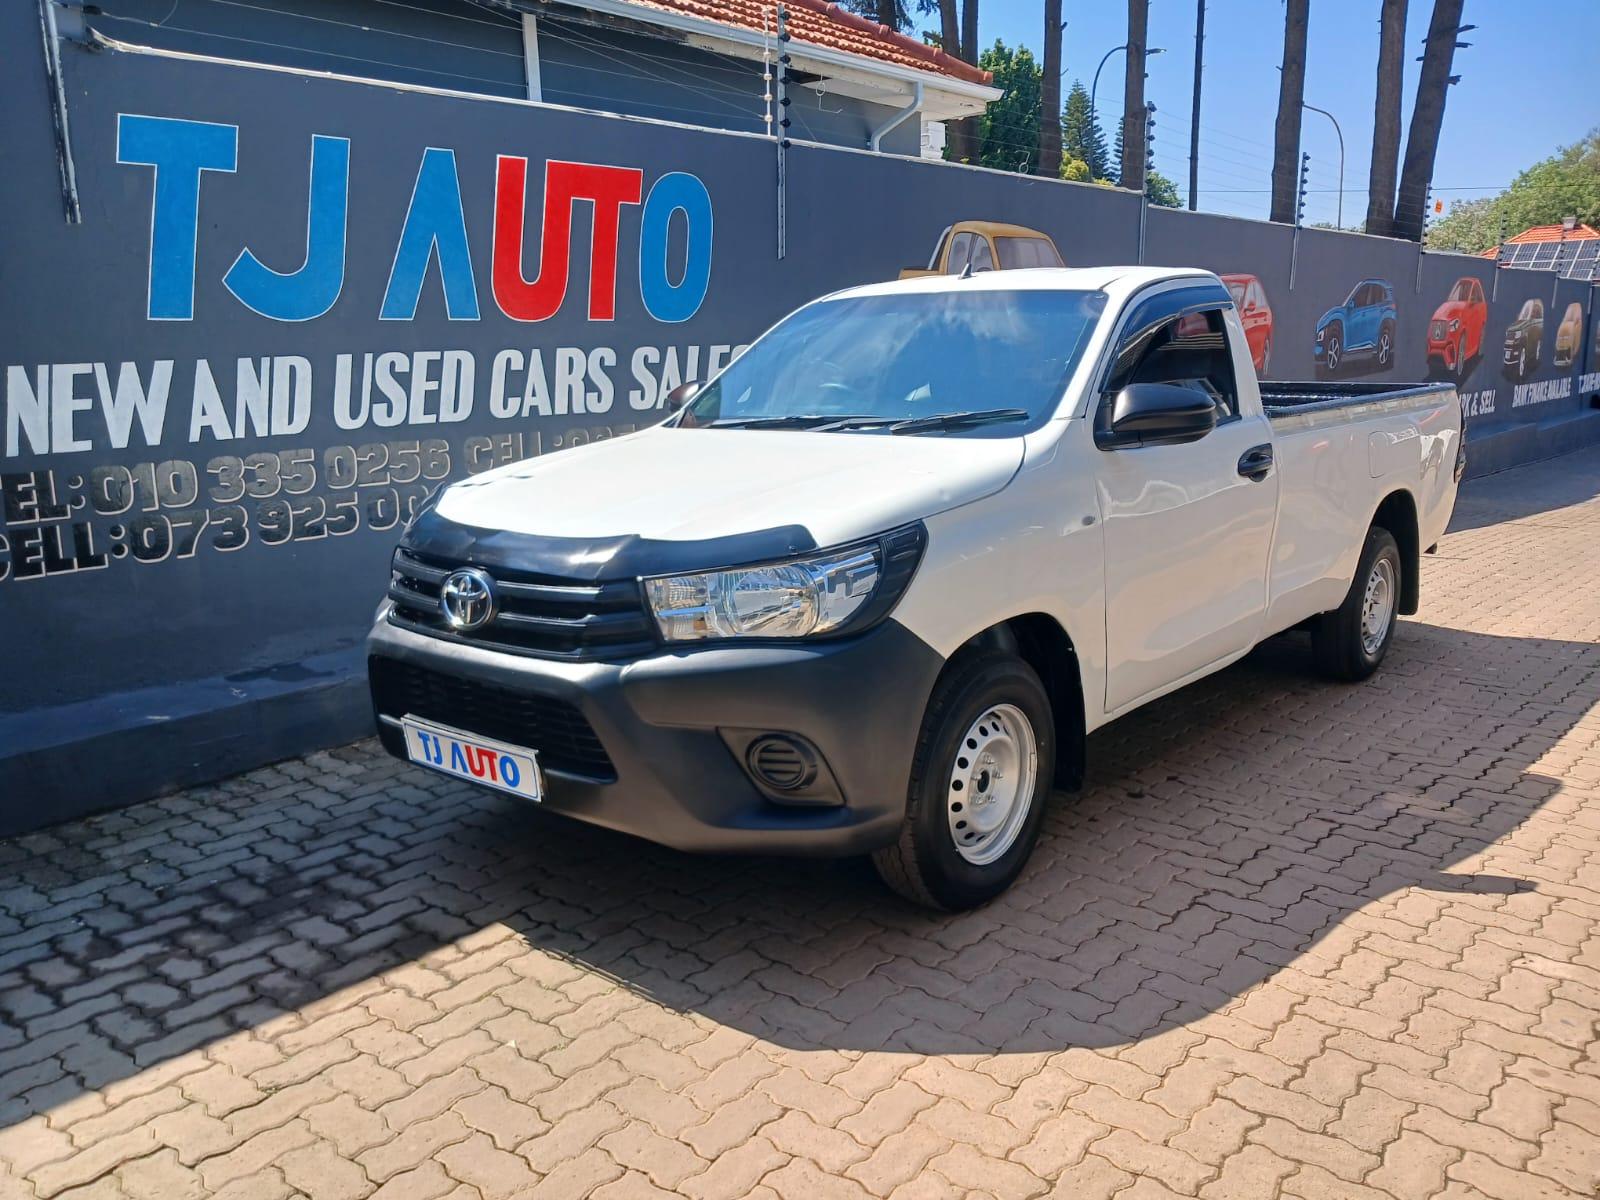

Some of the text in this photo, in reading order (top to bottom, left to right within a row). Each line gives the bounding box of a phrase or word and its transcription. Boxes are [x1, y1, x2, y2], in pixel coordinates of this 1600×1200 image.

[116, 112, 714, 323] TJ AUTO
[6, 345, 750, 457] NEW AND USED CARS SALE
[1479, 389, 1496, 415] SELL
[206, 448, 317, 503] 335
[323, 438, 450, 490] 0256
[256, 491, 361, 546] 925
[417, 731, 520, 788] TJ AUTO
